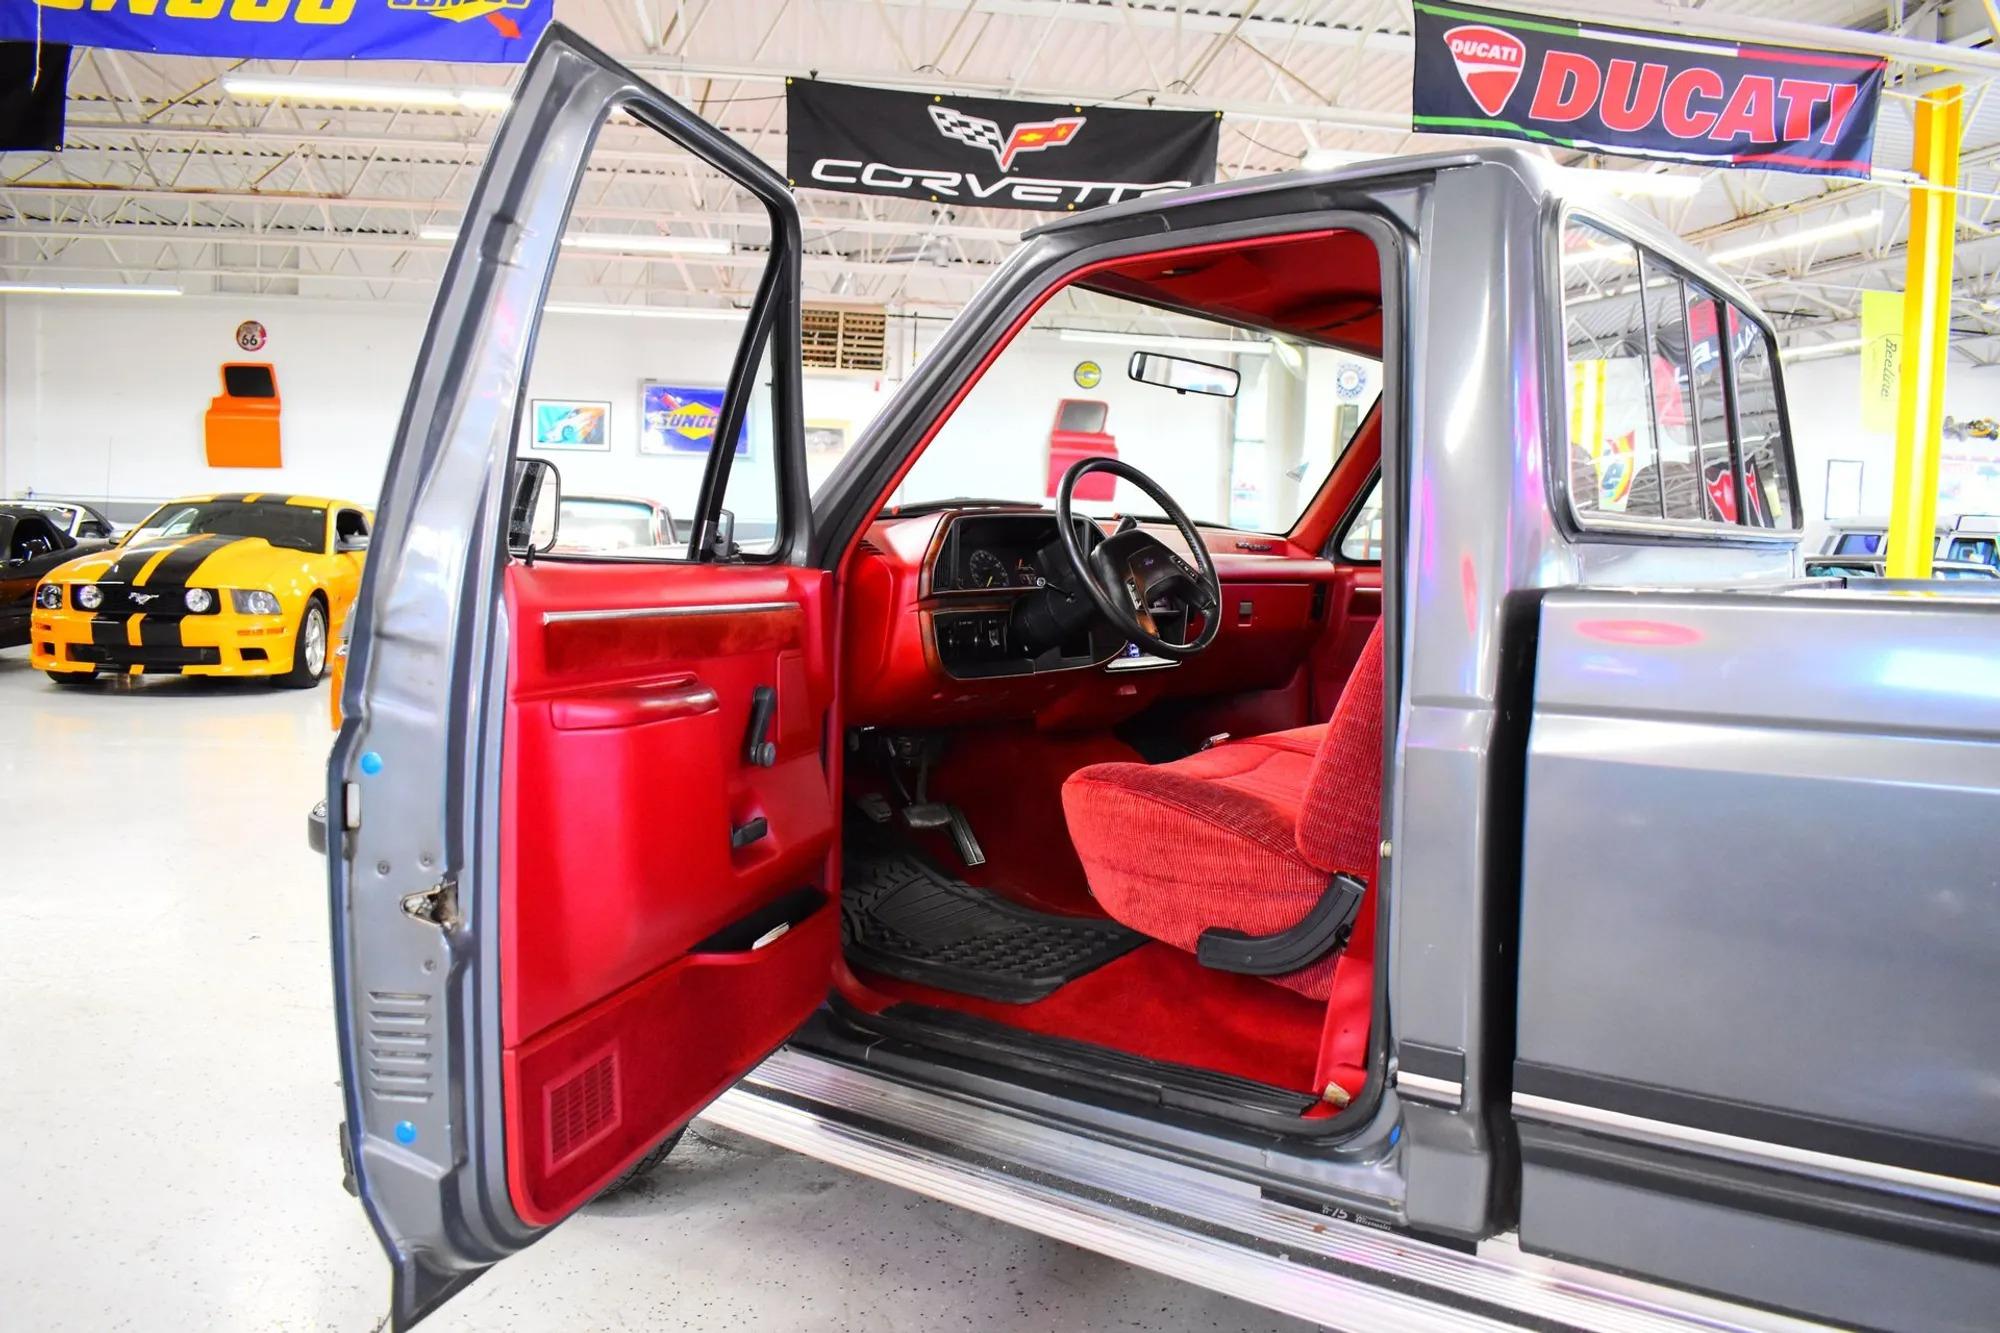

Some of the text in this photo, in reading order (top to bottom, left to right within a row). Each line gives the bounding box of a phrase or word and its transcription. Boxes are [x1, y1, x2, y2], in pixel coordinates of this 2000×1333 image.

[1451, 39, 1518, 63] DUCATI
[1528, 49, 1858, 145] DUCATI
[241, 333, 258, 346] 66
[659, 411, 720, 429] SUNOC
